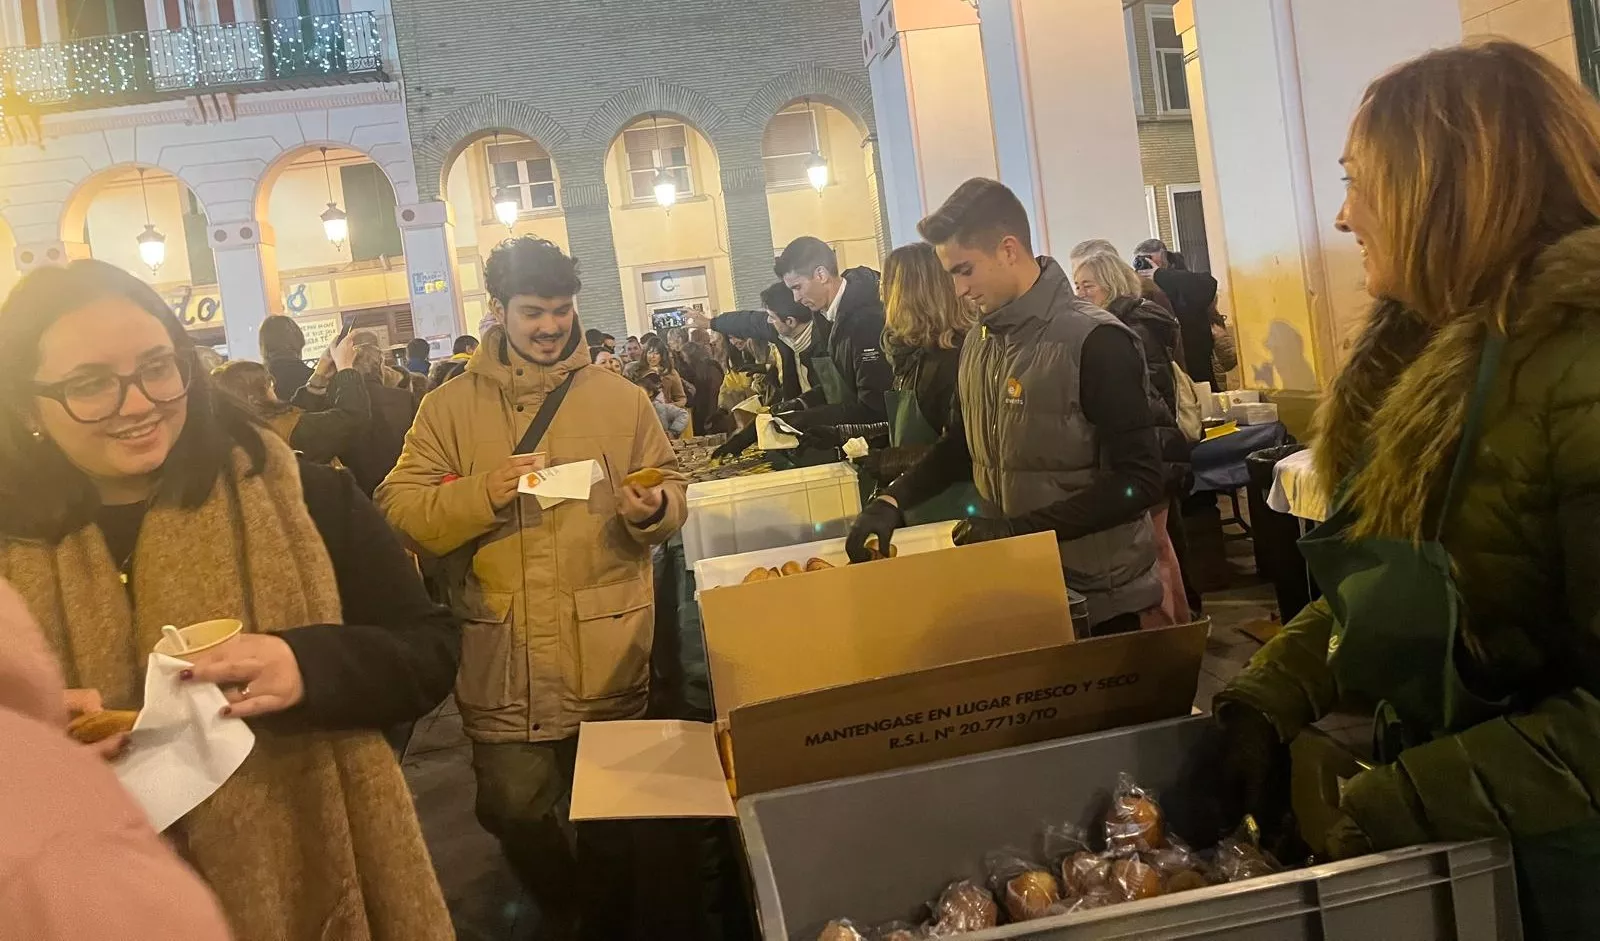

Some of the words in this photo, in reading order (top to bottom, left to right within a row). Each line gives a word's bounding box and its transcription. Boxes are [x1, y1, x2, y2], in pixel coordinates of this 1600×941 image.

[804, 711, 924, 747] MANTENGASE
[928, 706, 951, 722] EN
[955, 695, 1012, 716] LUGAR
[1015, 683, 1078, 705] FRESCO
[1082, 679, 1093, 693] Y
[1096, 672, 1140, 690] SECO
[889, 732, 930, 749] R.S.I.
[960, 706, 1058, 736] 20.7713/TO
